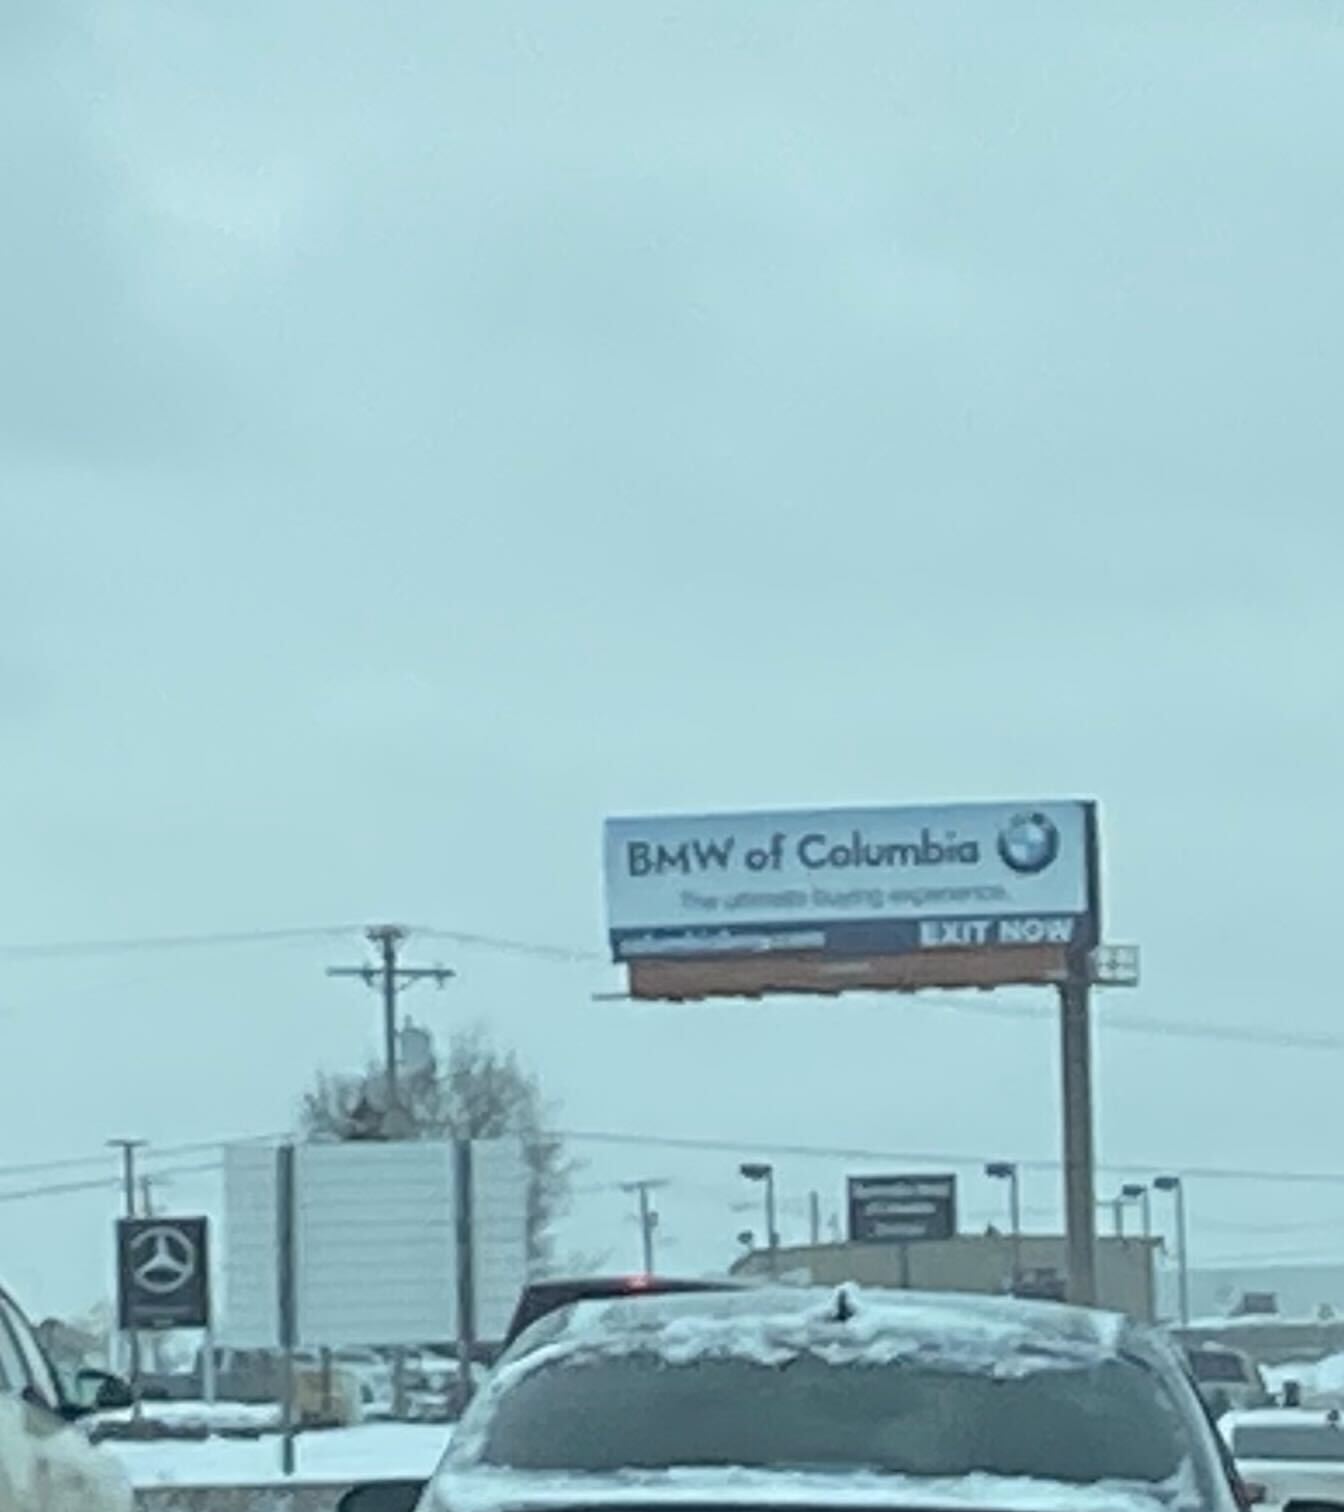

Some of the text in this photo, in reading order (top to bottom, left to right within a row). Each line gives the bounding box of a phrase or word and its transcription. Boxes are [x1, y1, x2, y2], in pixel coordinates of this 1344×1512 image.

[627, 827, 980, 877] BMW of Columbia
[919, 917, 1073, 946] EXIT NOW
